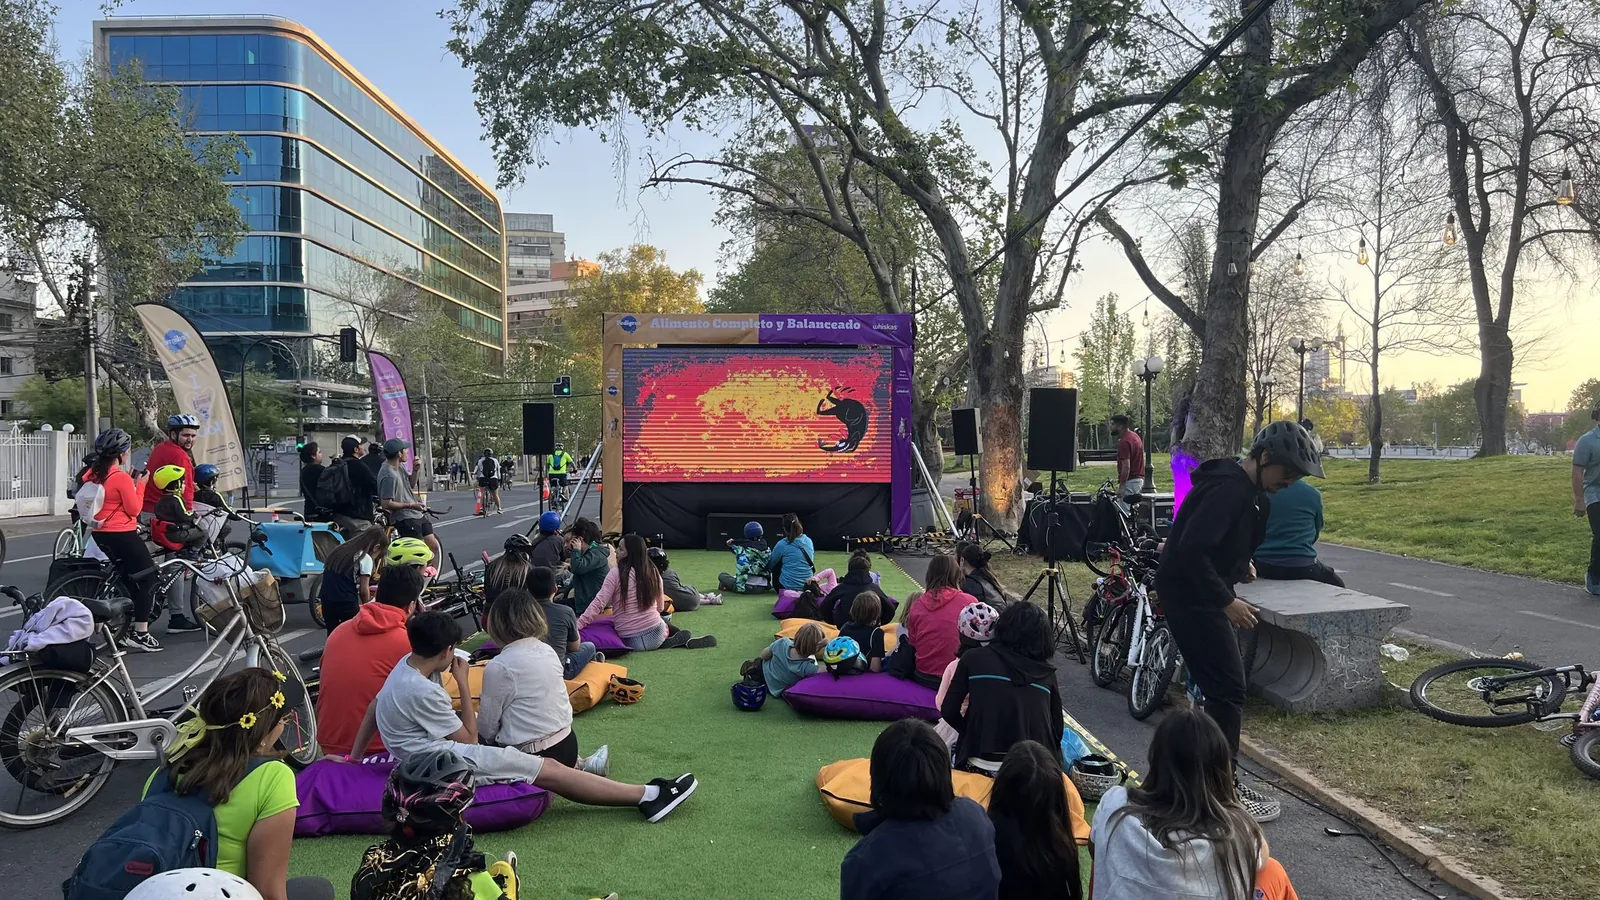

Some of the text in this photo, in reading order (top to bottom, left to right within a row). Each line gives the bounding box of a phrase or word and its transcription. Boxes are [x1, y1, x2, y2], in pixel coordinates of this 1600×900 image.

[650, 317, 861, 331] Alimento Completo y Balanceado
